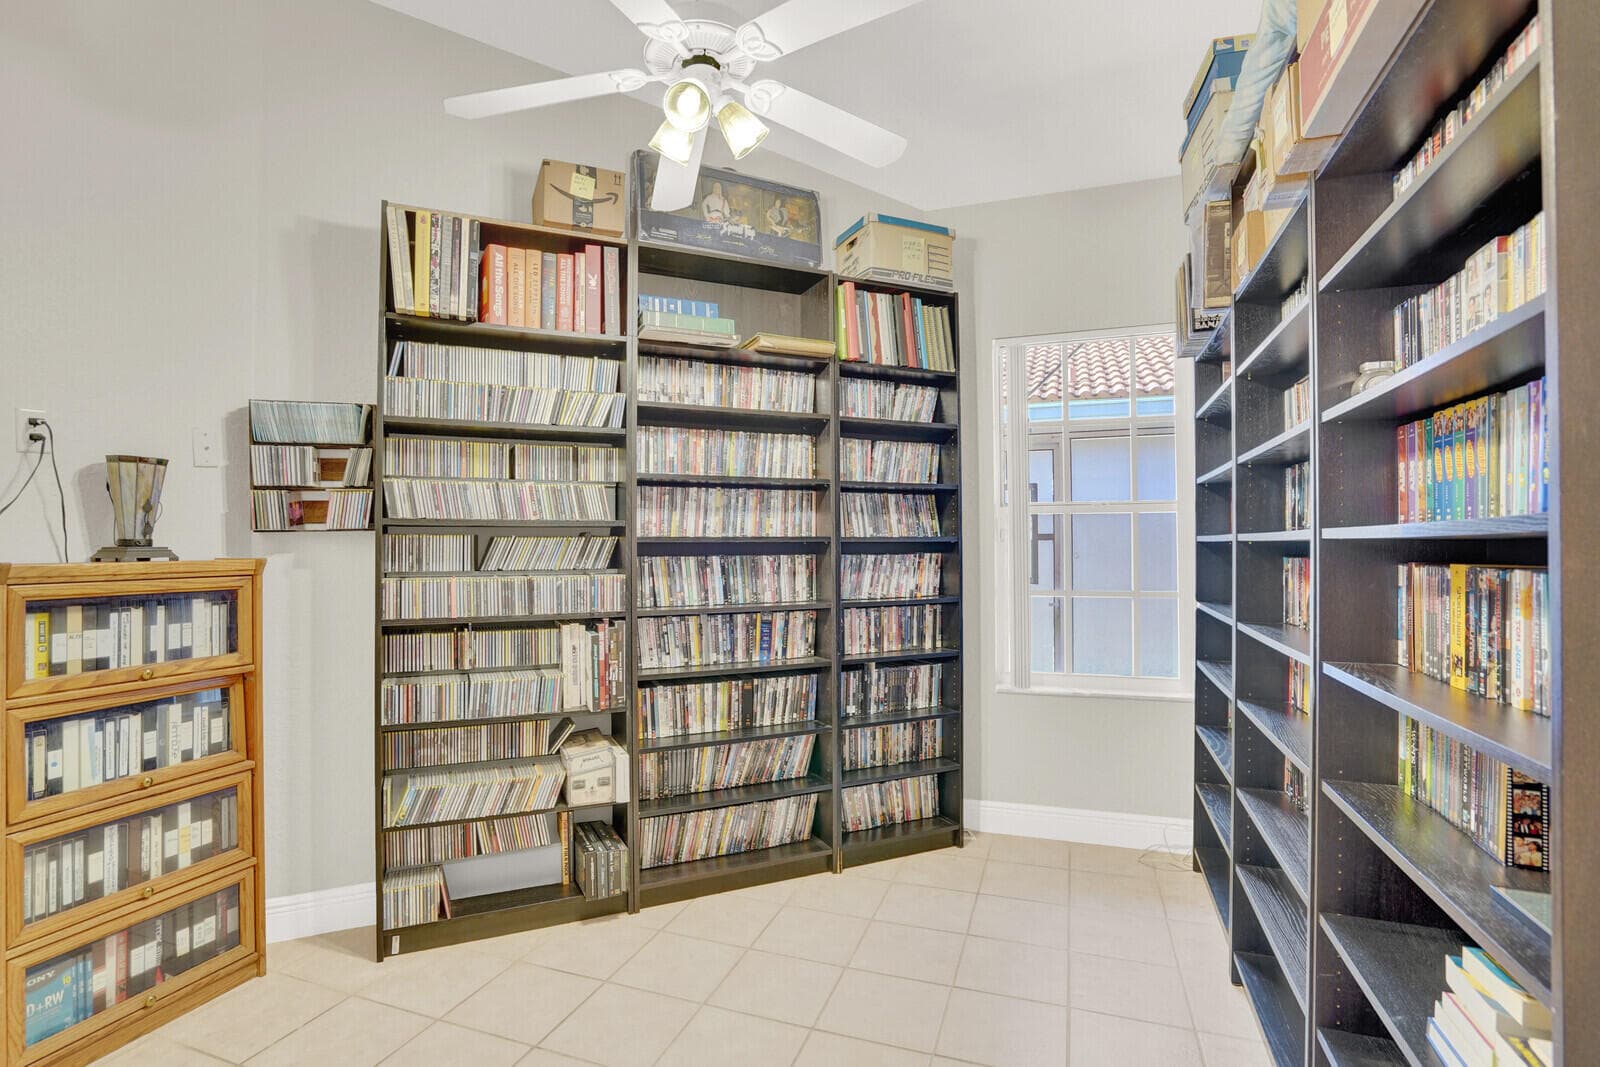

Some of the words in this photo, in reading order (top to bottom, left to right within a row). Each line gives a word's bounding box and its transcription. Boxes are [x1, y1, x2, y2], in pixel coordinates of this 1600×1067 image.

[494, 252, 503, 268] All
[494, 268, 504, 285] the
[493, 284, 504, 318] Songs
[26, 969, 56, 987] ONY
